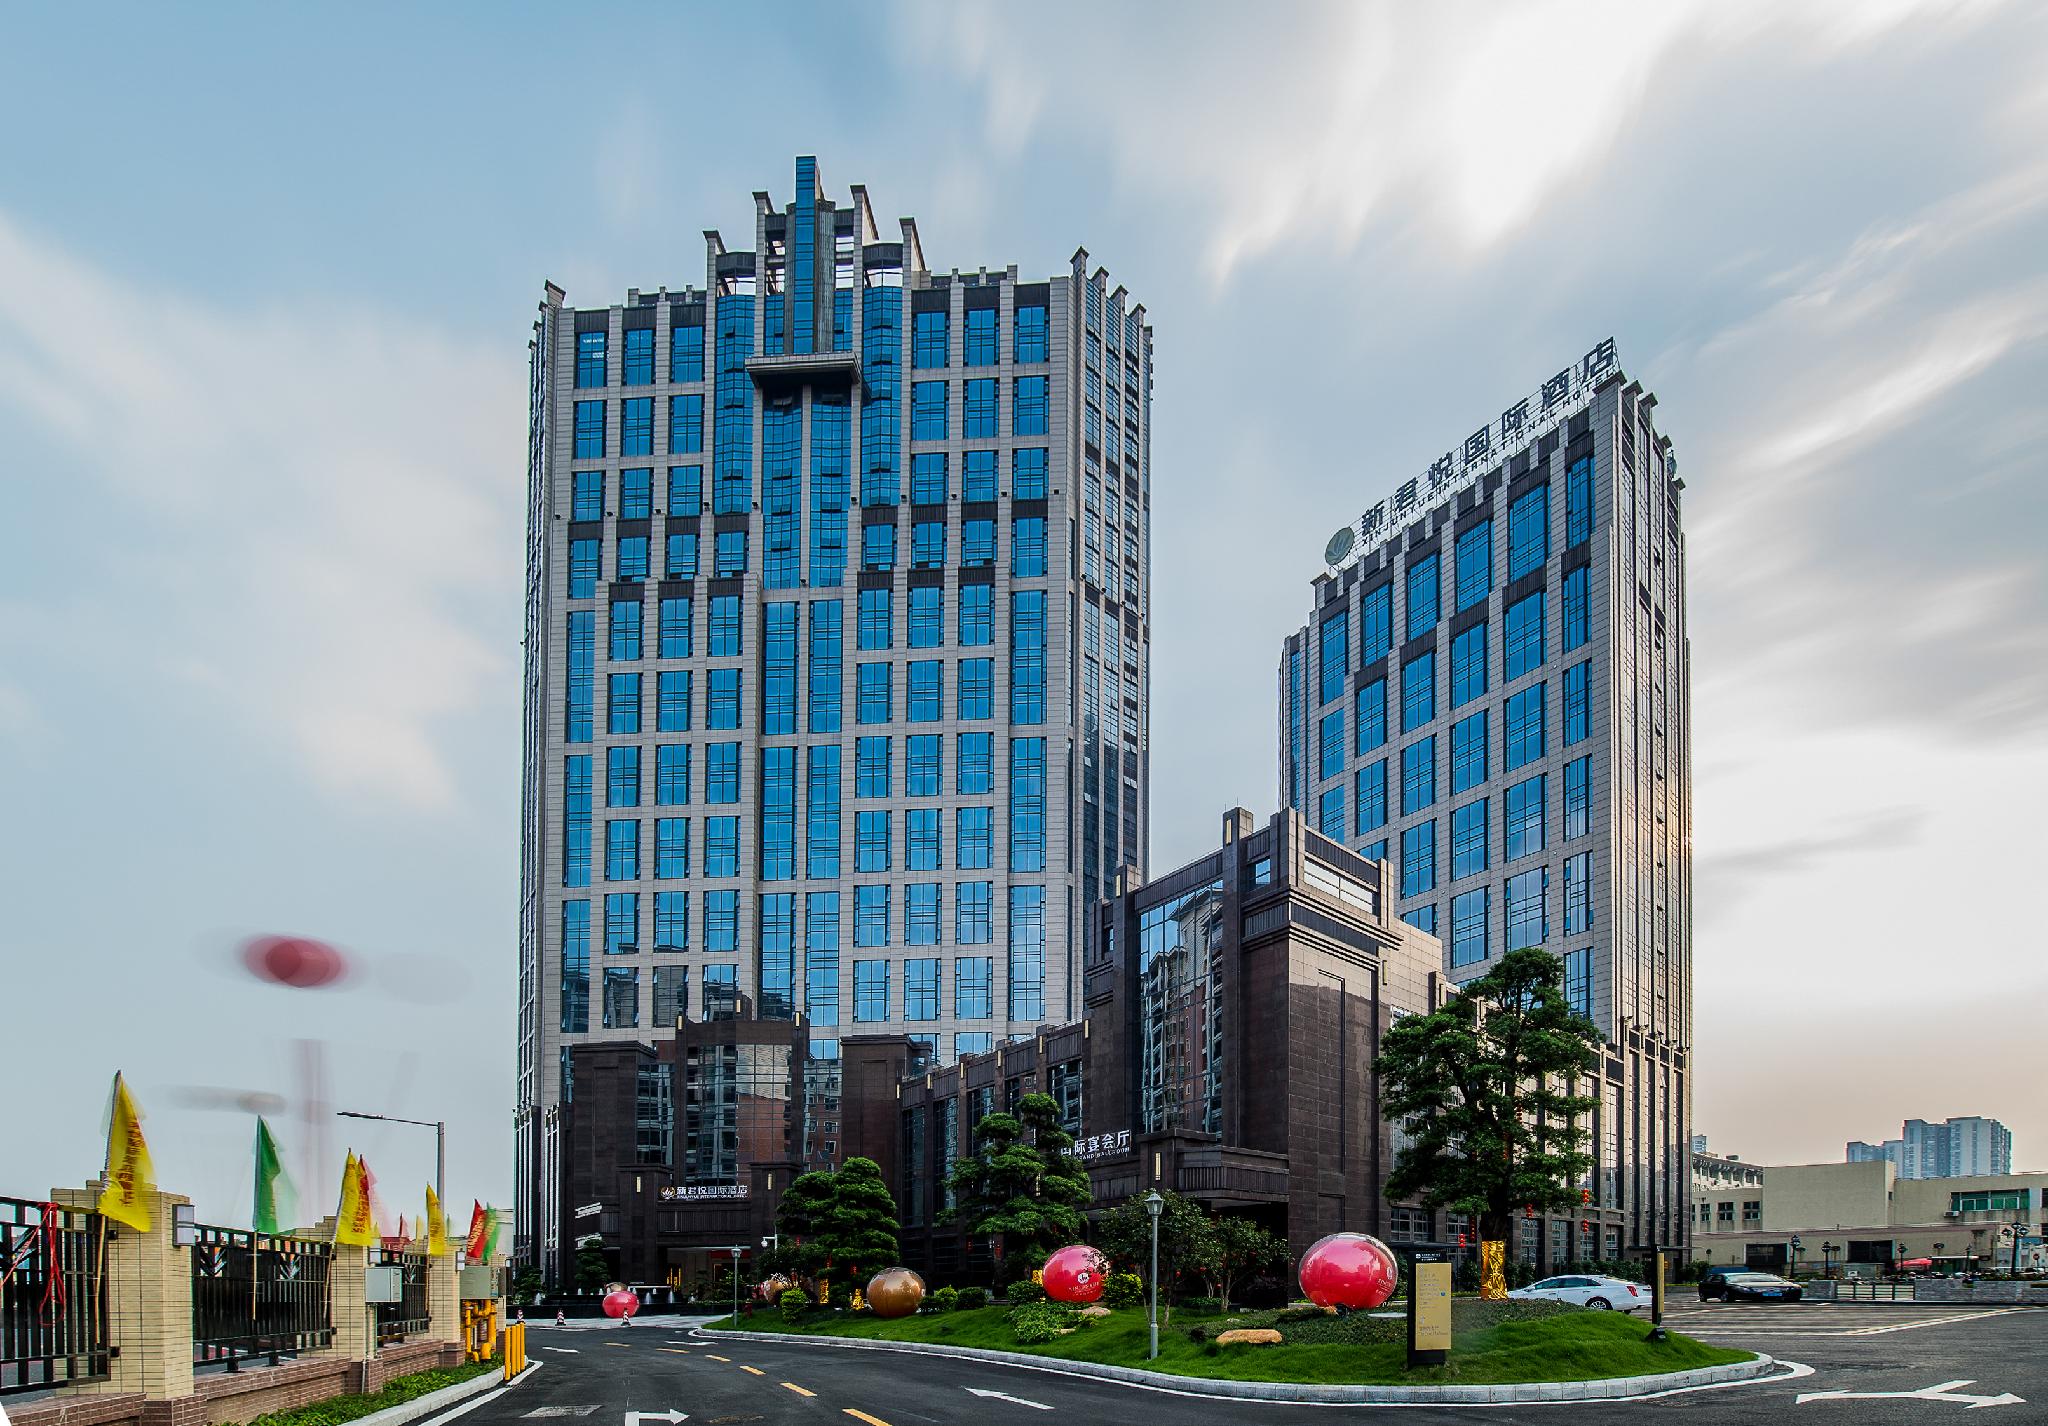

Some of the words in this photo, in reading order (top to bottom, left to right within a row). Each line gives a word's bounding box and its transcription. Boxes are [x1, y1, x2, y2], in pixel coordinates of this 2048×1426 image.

[1562, 367, 1615, 409] HOTEL
[1361, 336, 1614, 538] 新君悦国际酒店
[676, 1185, 748, 1195] 新君悦国际酒店
